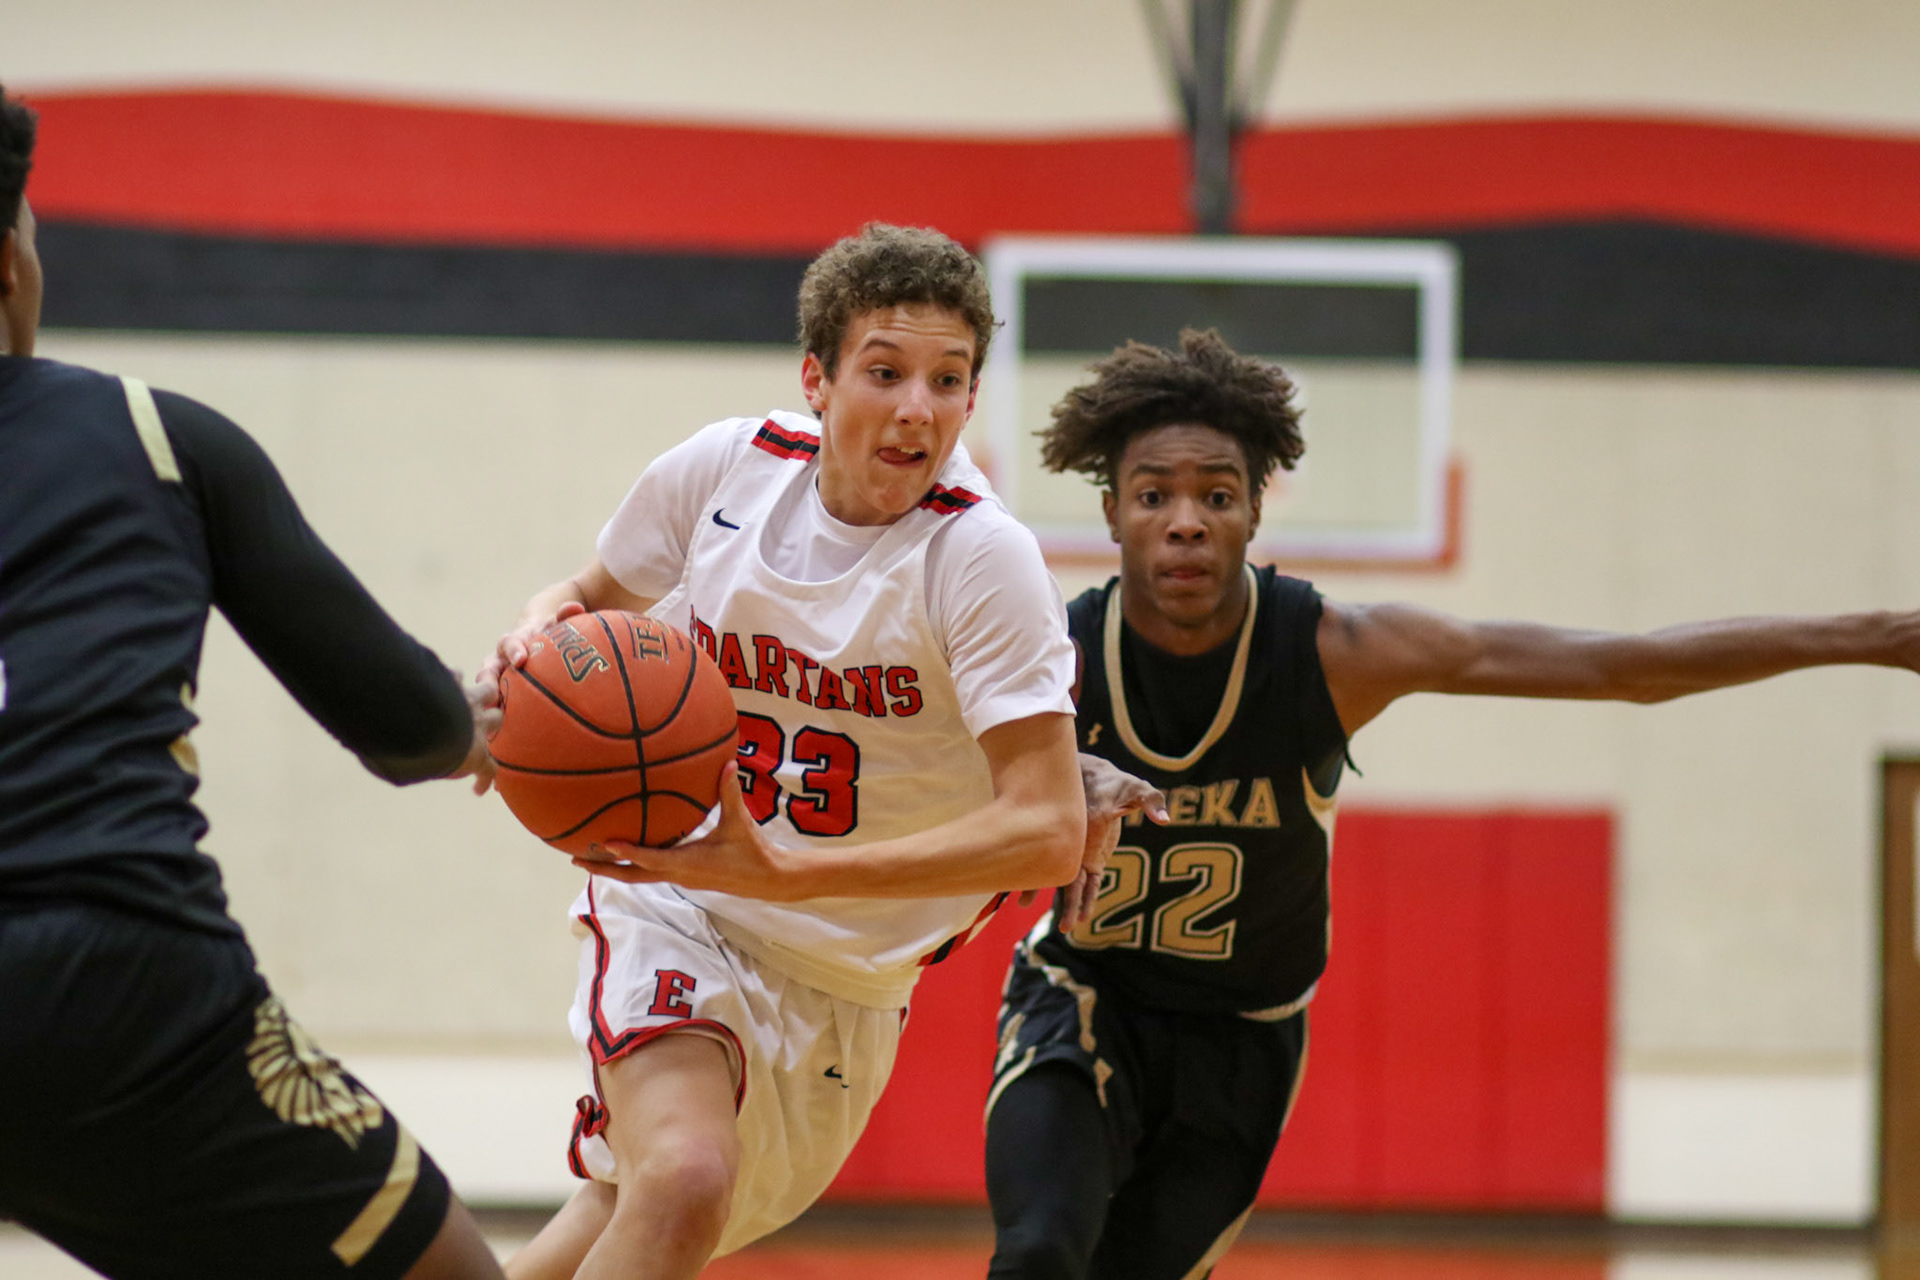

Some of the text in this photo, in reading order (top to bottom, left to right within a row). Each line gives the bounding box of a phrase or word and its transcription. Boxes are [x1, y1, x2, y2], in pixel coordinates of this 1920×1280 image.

[737, 711, 861, 837] 33
[1066, 841, 1244, 960] 22
[647, 969, 697, 1018] E
